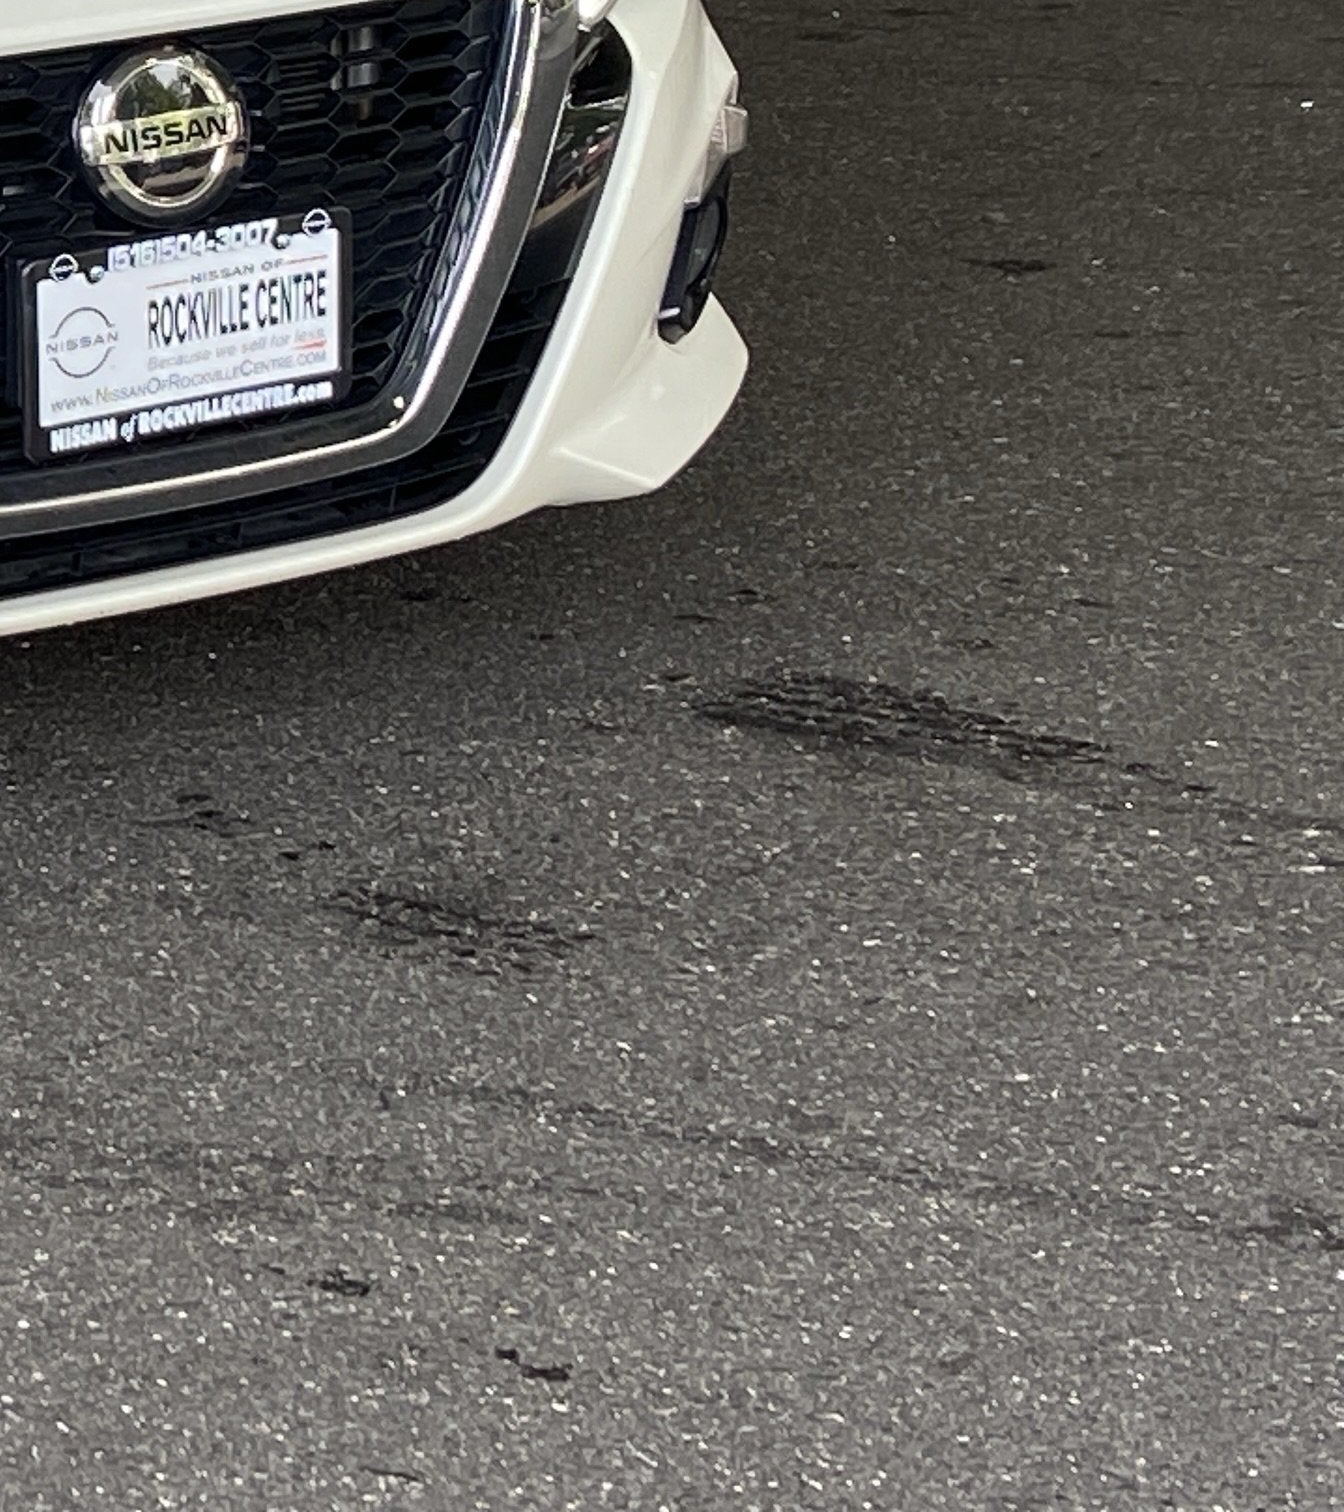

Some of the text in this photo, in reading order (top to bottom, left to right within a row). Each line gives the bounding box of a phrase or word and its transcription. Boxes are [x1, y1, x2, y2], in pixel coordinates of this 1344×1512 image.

[104, 115, 227, 154] NISSAN
[190, 258, 285, 284] NISSAN OF
[148, 269, 327, 349] ROCKVILLE CENTRE
[46, 332, 118, 355] NISSAN
[147, 350, 212, 371] Because
[216, 345, 236, 358] we
[50, 417, 118, 453] NISSAN
[120, 413, 139, 443] of
